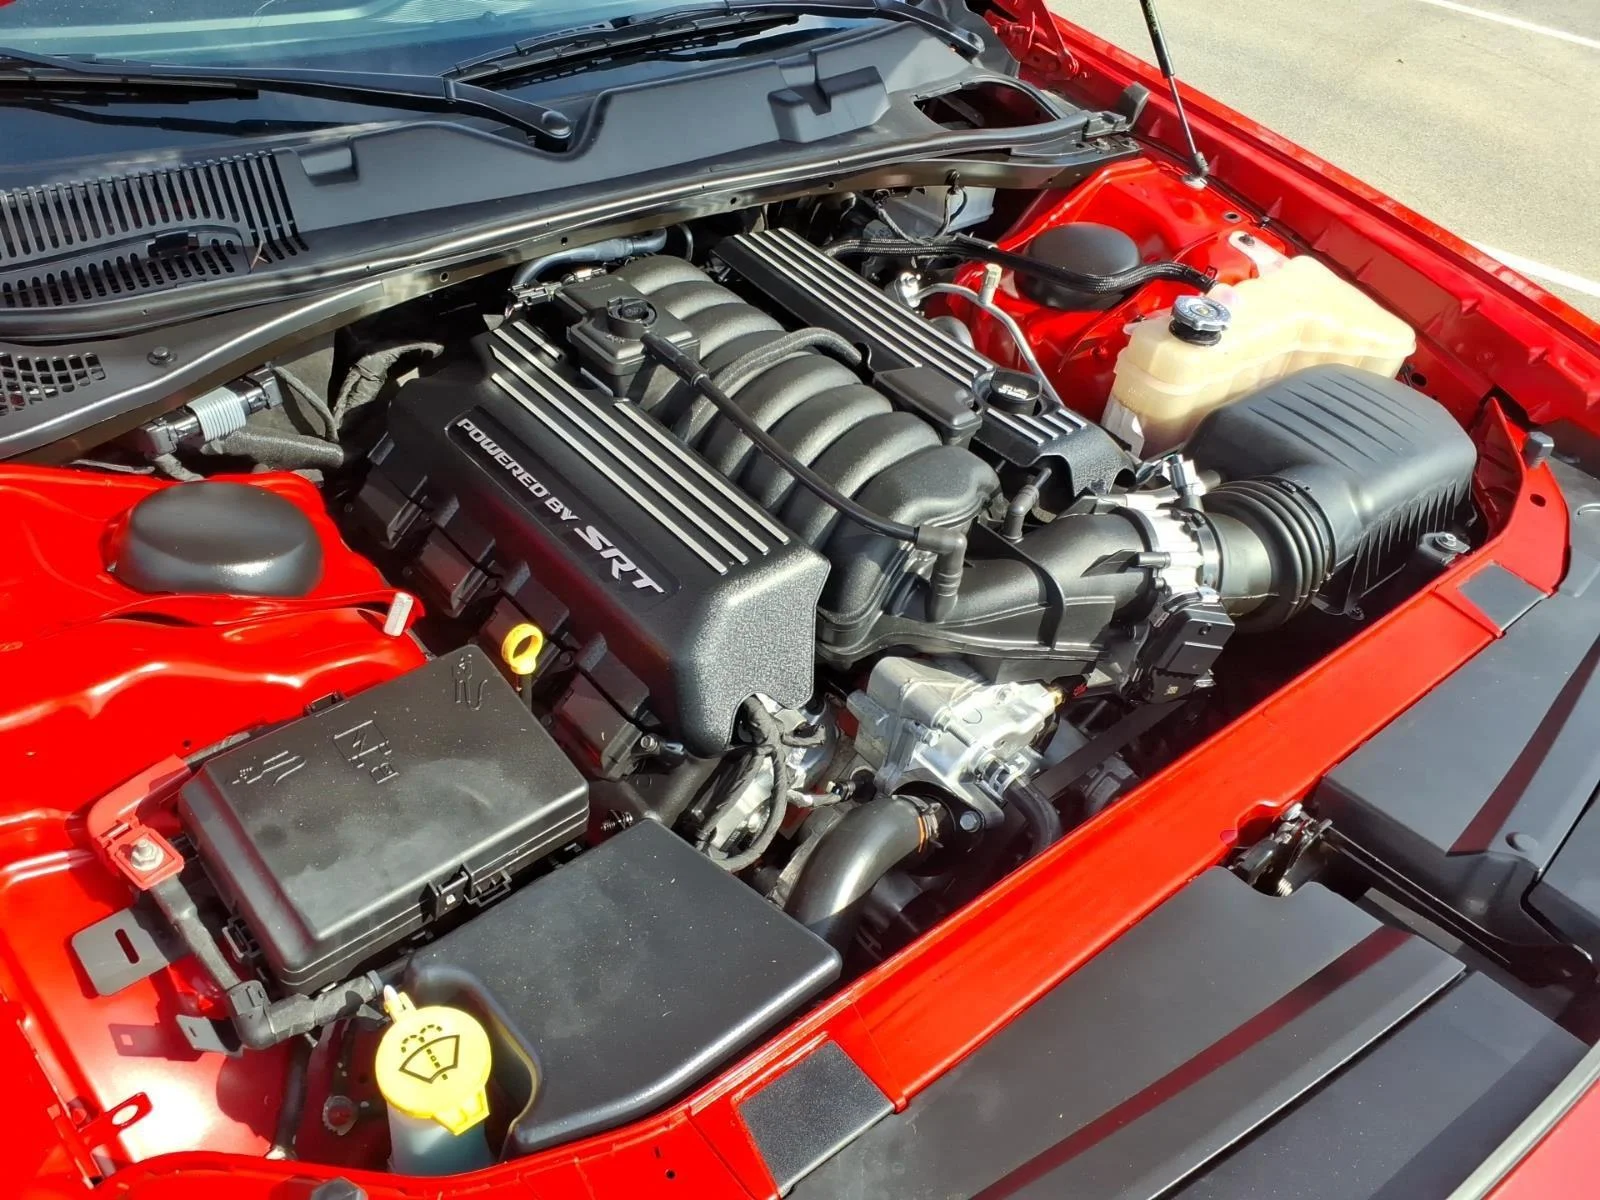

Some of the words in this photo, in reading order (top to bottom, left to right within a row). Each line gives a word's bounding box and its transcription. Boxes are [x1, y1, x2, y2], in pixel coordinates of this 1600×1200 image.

[457, 418, 550, 498] POWERED
[544, 497, 581, 521] BY
[574, 525, 665, 593] SRT
